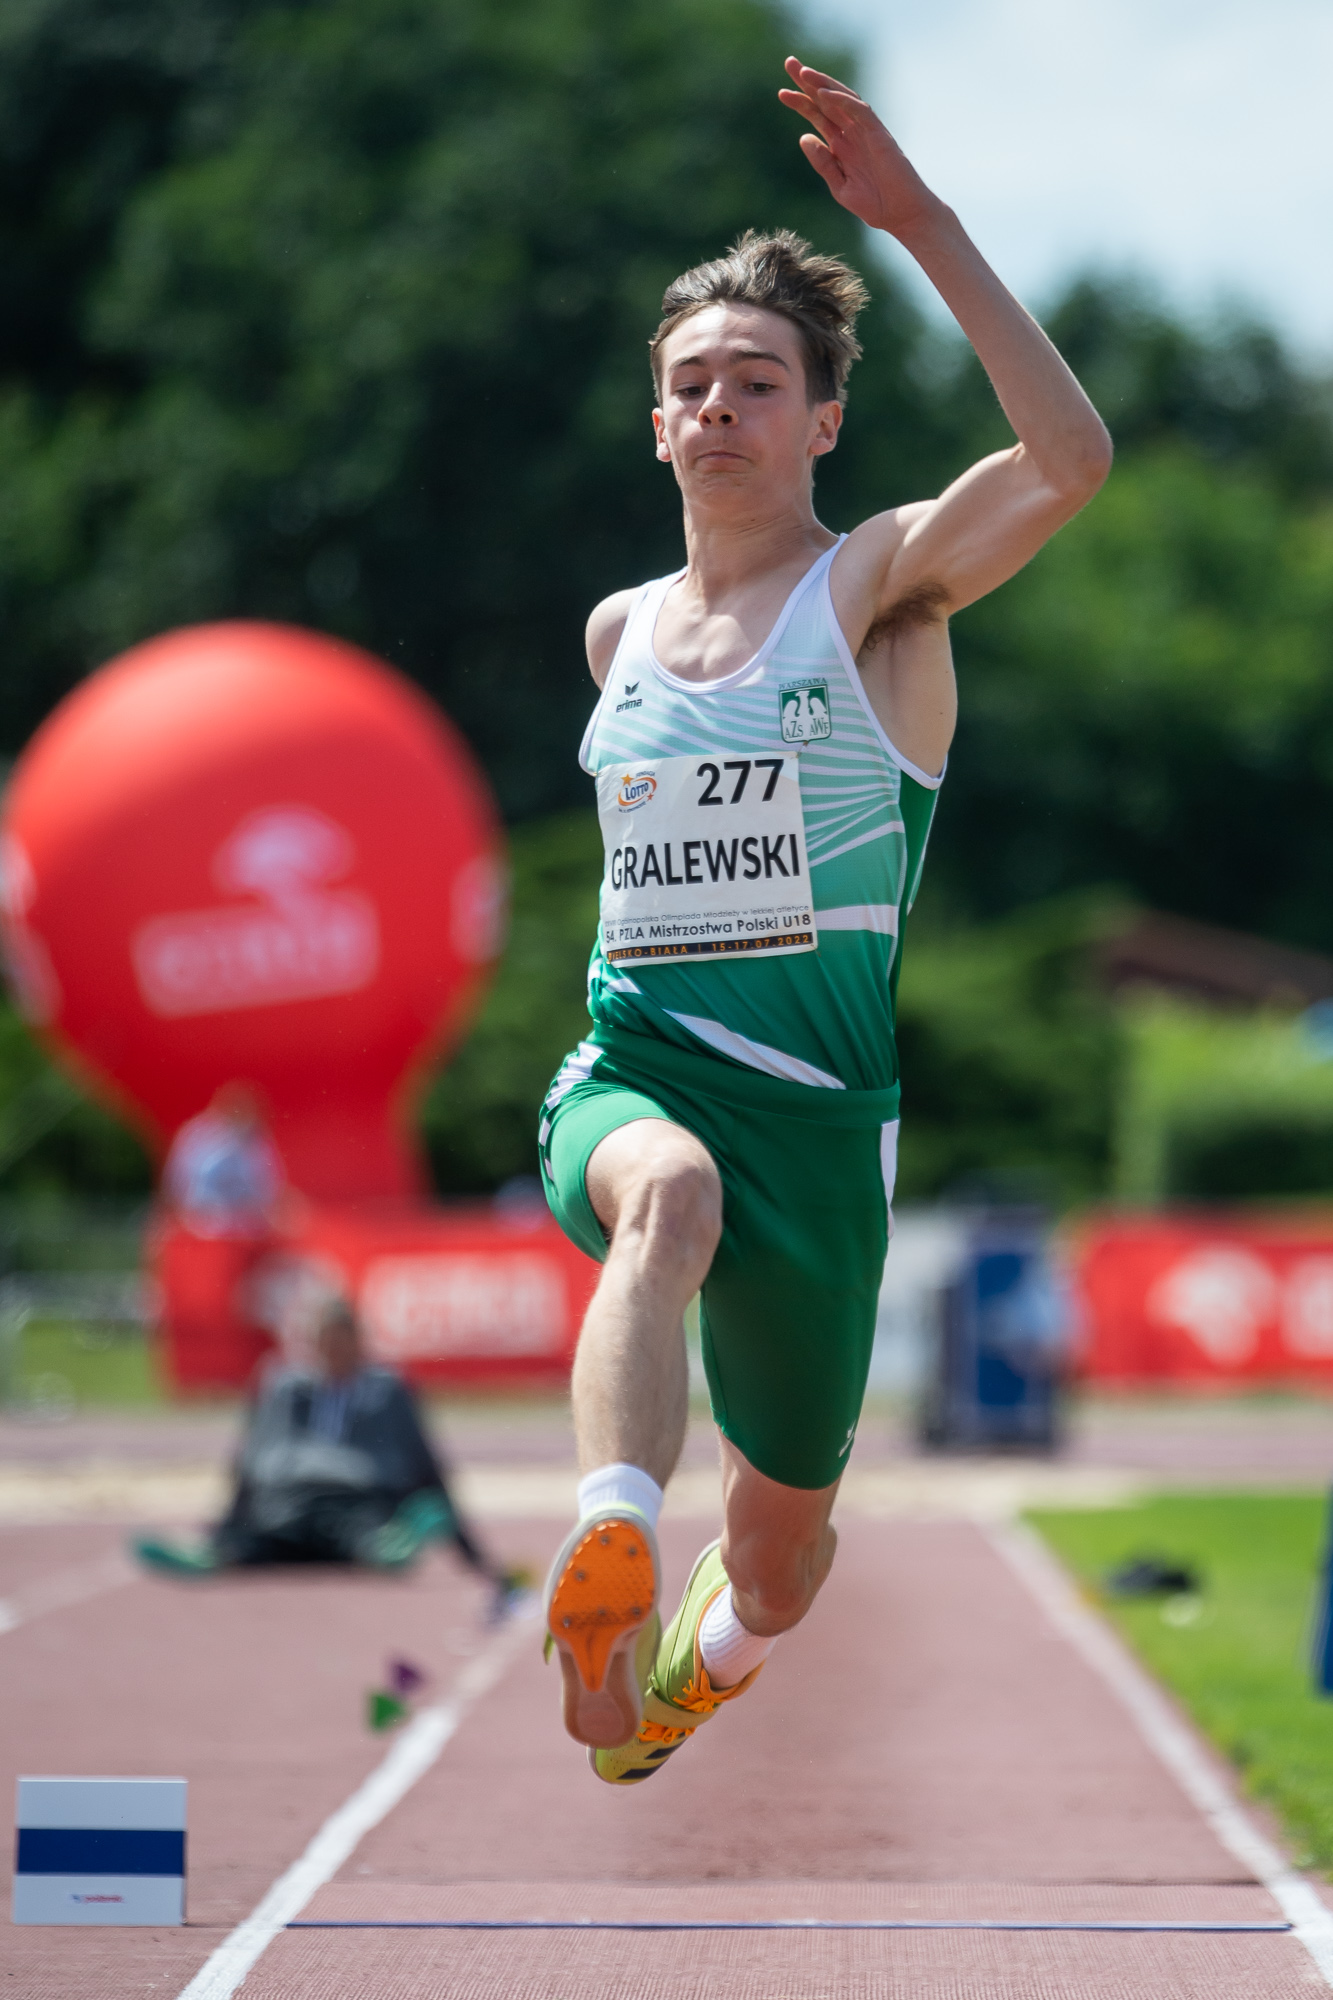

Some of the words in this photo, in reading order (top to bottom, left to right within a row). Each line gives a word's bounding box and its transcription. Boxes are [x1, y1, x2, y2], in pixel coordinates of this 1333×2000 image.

[779, 677, 827, 690] WARSZAWA
[616, 698, 643, 713] erima
[625, 782, 649, 801] LOTTO
[697, 759, 784, 806] 277
[611, 833, 800, 891] GRALEWSKI
[661, 912, 701, 923] Olimpiada
[750, 906, 775, 915] lekkiej
[776, 905, 809, 914] atletyce
[619, 926, 645, 941] PZLA
[649, 921, 733, 939] Mistrzostwa
[737, 916, 779, 933] Polski
[782, 913, 812, 928] U18
[712, 934, 809, 952] 15-17.07.2022
